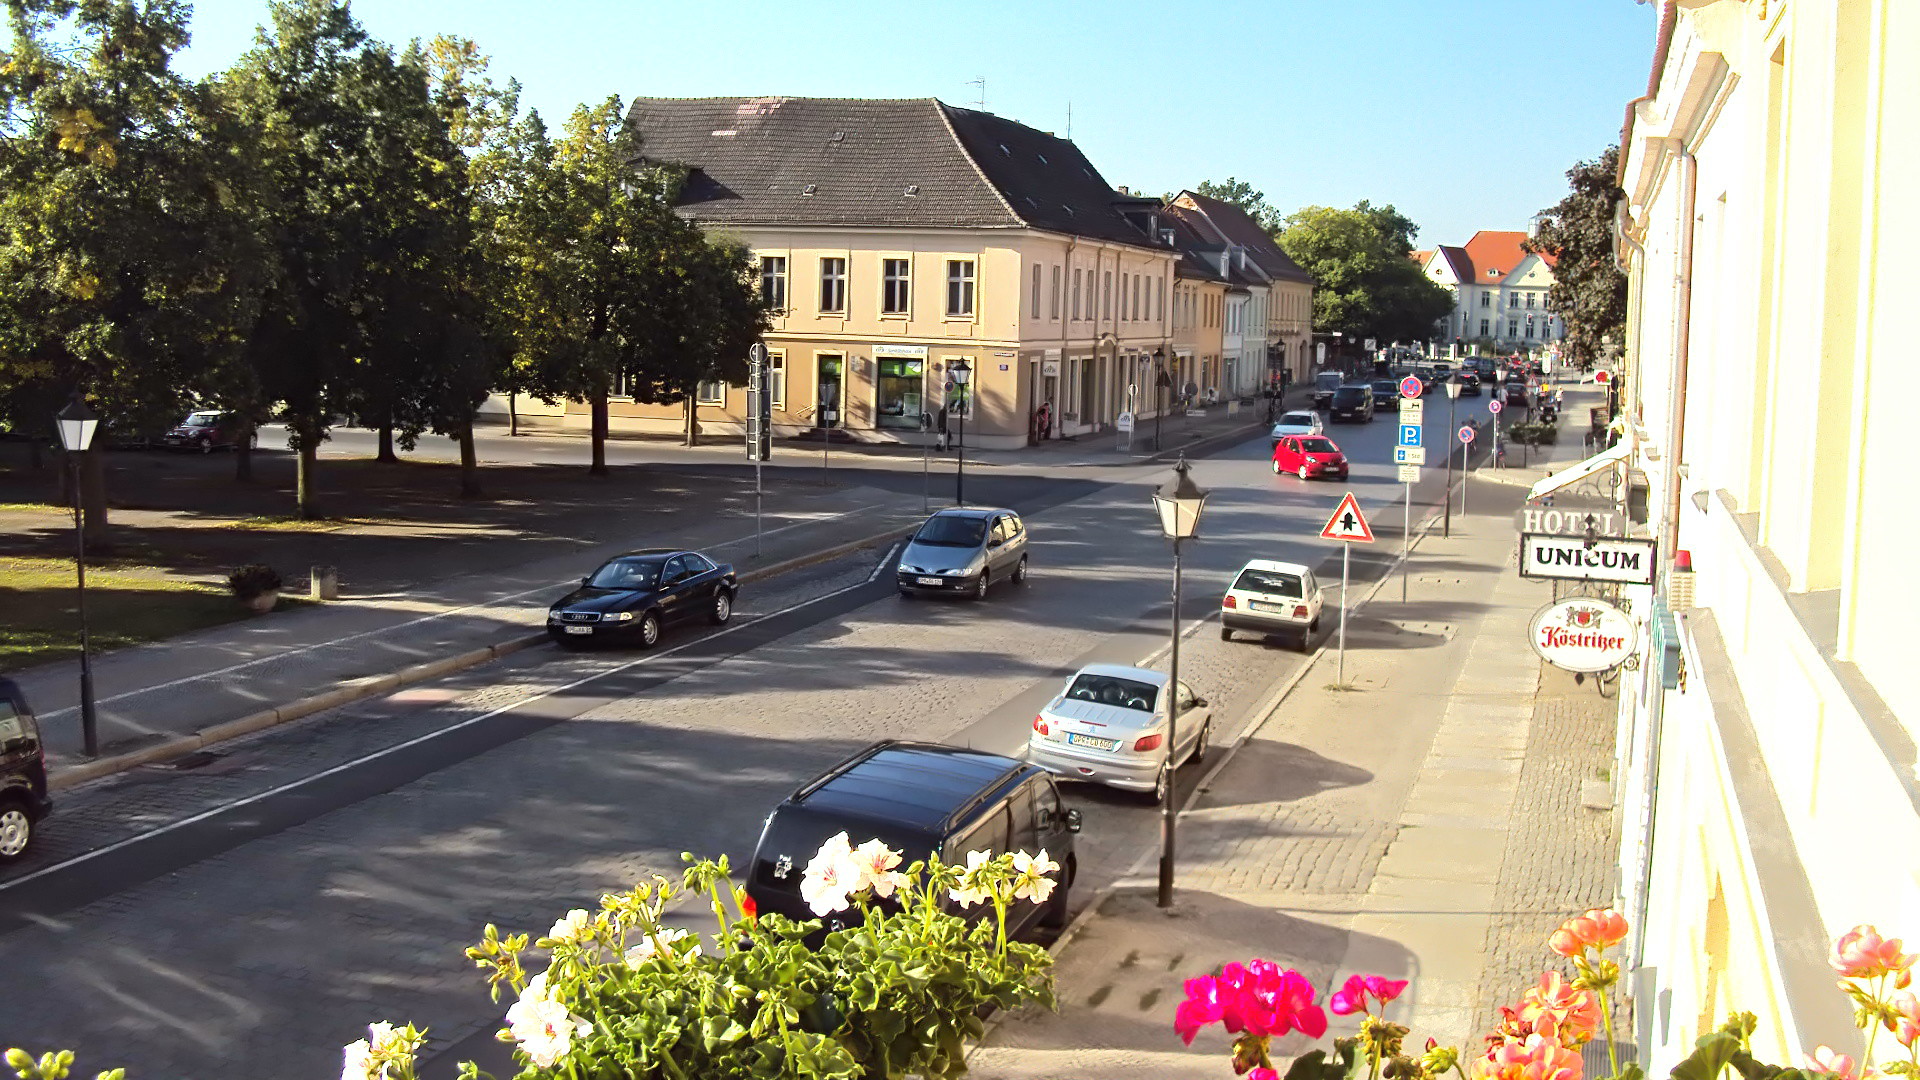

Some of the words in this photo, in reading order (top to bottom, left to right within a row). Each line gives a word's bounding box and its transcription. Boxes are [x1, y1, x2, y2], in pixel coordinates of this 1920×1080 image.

[1404, 427, 1417, 444] P
[1536, 547, 1640, 570] UNICUM
[1541, 626, 1625, 653] Köstritzer
